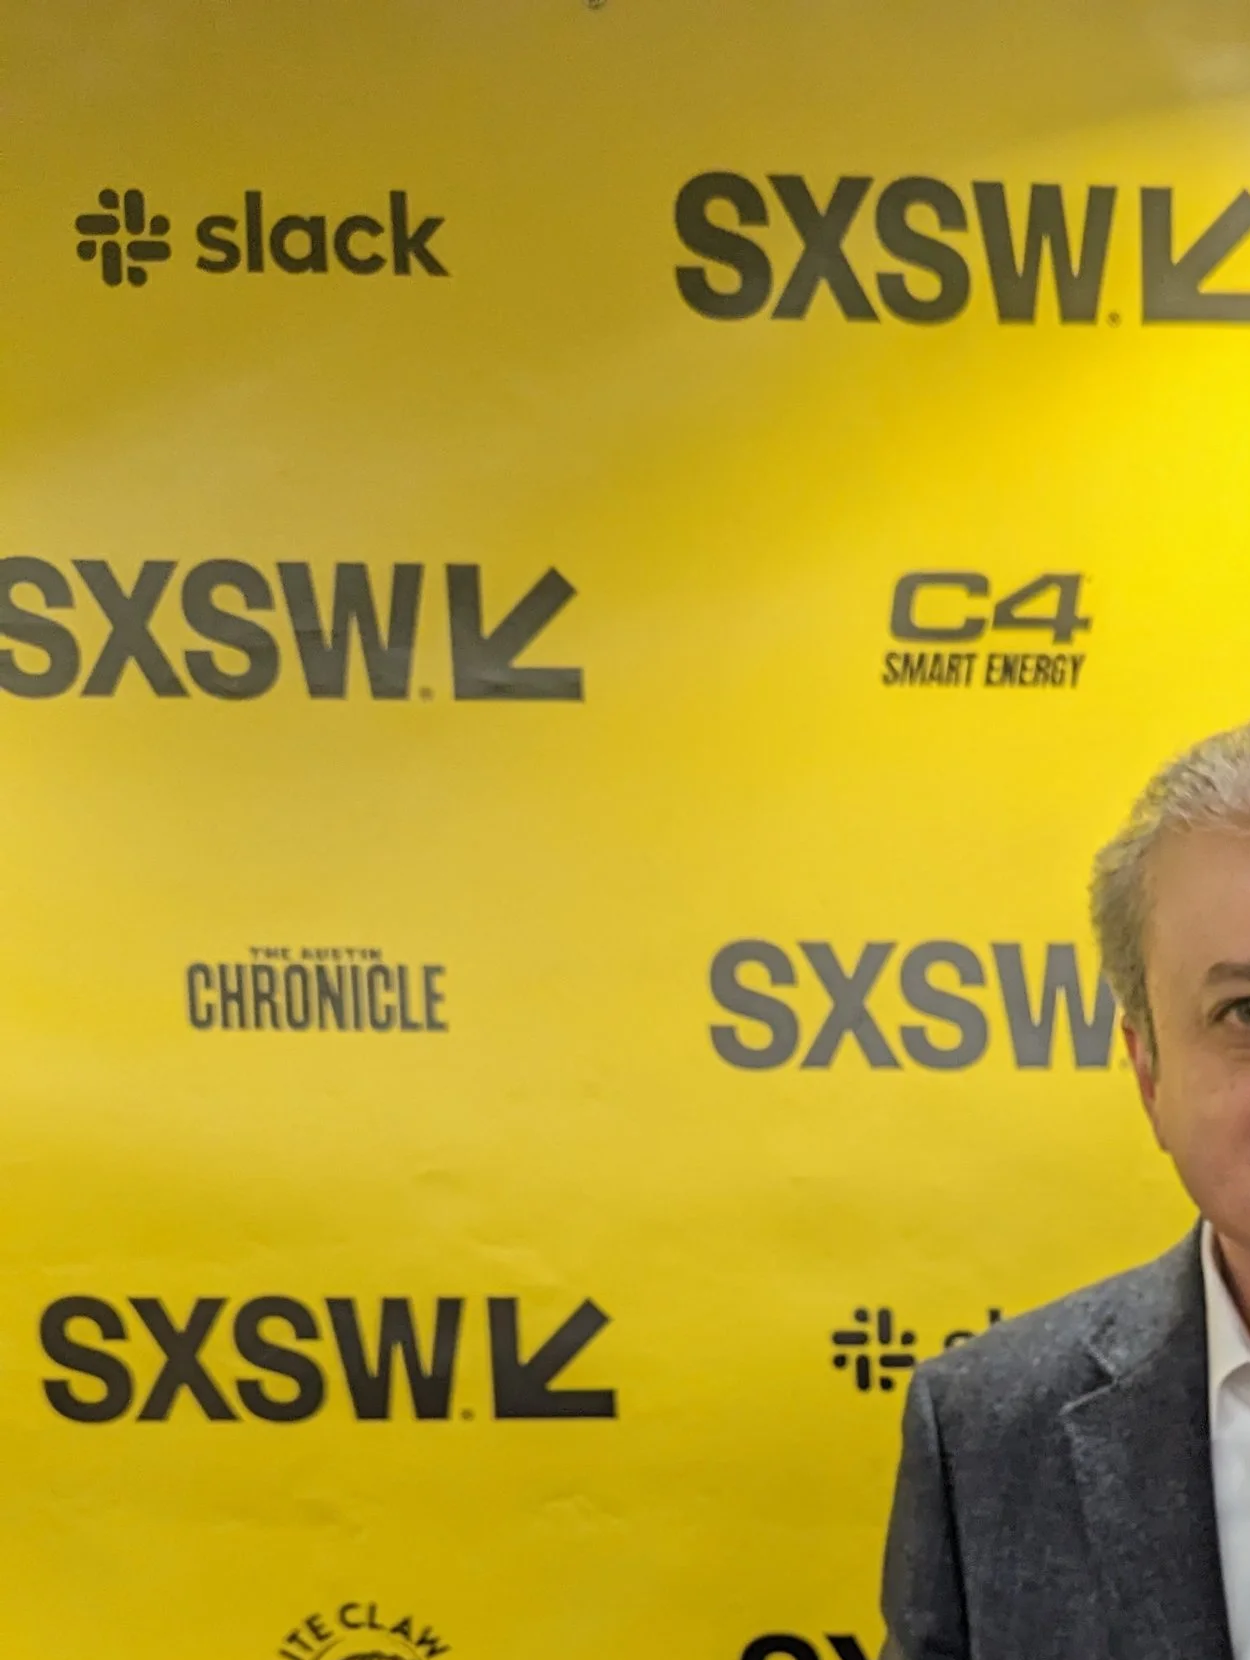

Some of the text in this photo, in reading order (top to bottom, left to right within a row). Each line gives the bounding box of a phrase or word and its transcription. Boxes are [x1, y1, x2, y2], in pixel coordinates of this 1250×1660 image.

[195, 189, 449, 277] slack
[673, 171, 1117, 326] SXSW
[0, 556, 424, 701] SXSW
[889, 571, 1090, 645] C4
[882, 652, 1085, 689] SMART ENERGY
[187, 962, 449, 1032] CHRONICLE
[38, 1294, 465, 1423] SXSW
[338, 1602, 452, 1659] CLAW
